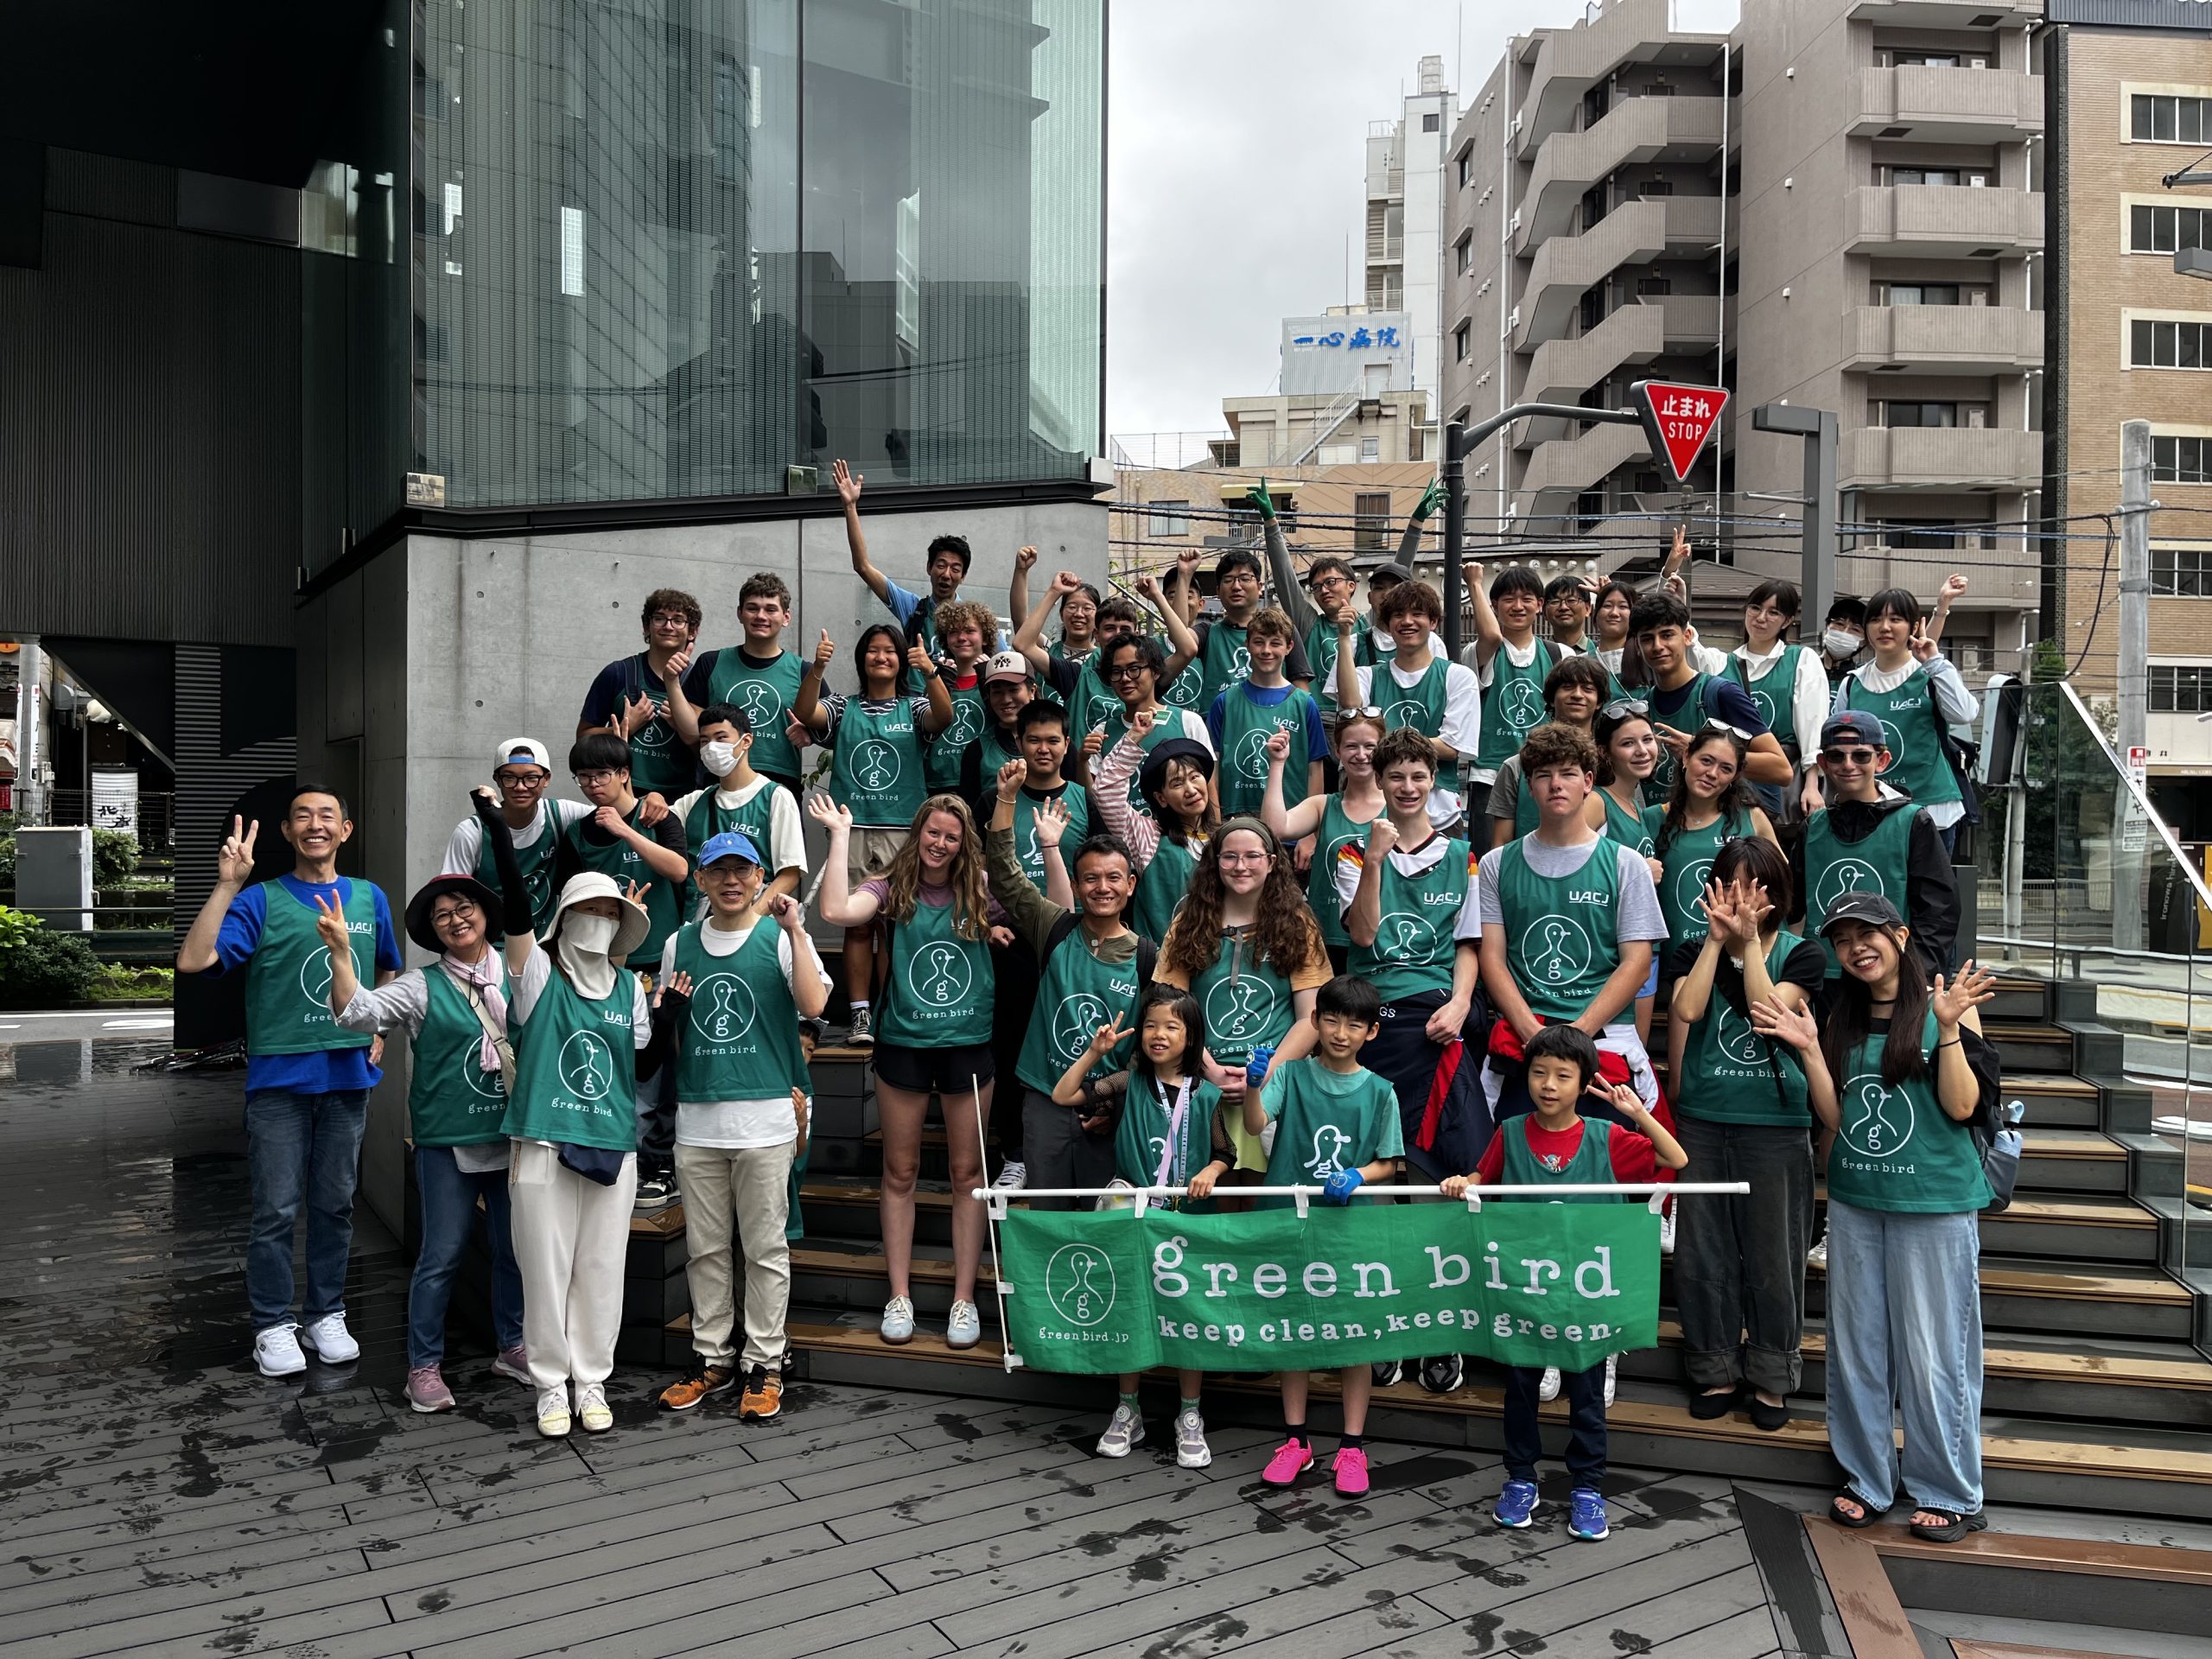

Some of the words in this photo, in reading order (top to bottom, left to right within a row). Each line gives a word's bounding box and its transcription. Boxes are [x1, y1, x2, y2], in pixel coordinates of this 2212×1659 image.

[1661, 394, 1711, 418] 止まれ
[1668, 422, 1702, 441] STOP
[1890, 698, 1922, 710] UACJ
[885, 723, 913, 733] UACJ
[1272, 715, 1300, 733] UACJ
[729, 821, 760, 838] UACJ
[1424, 892, 1462, 906] UACJ
[1569, 890, 1609, 906] UACJ
[346, 921, 372, 934] UACJ
[1683, 929, 1707, 938] gree
[1108, 978, 1137, 997] UAC
[304, 1013, 332, 1023] gree
[912, 1009, 947, 1019] green
[950, 1007, 975, 1017] bird
[695, 1046, 726, 1056] green
[729, 1045, 757, 1054] bird
[1714, 1065, 1754, 1077] green
[551, 1097, 589, 1112] green
[1841, 1157, 1878, 1171] green
[1882, 1163, 1915, 1173] bird
[1152, 1236, 1402, 1299] green
[1424, 1241, 1621, 1299] bird
[1158, 1315, 1245, 1347] keep
[1493, 1313, 1622, 1343] green.
